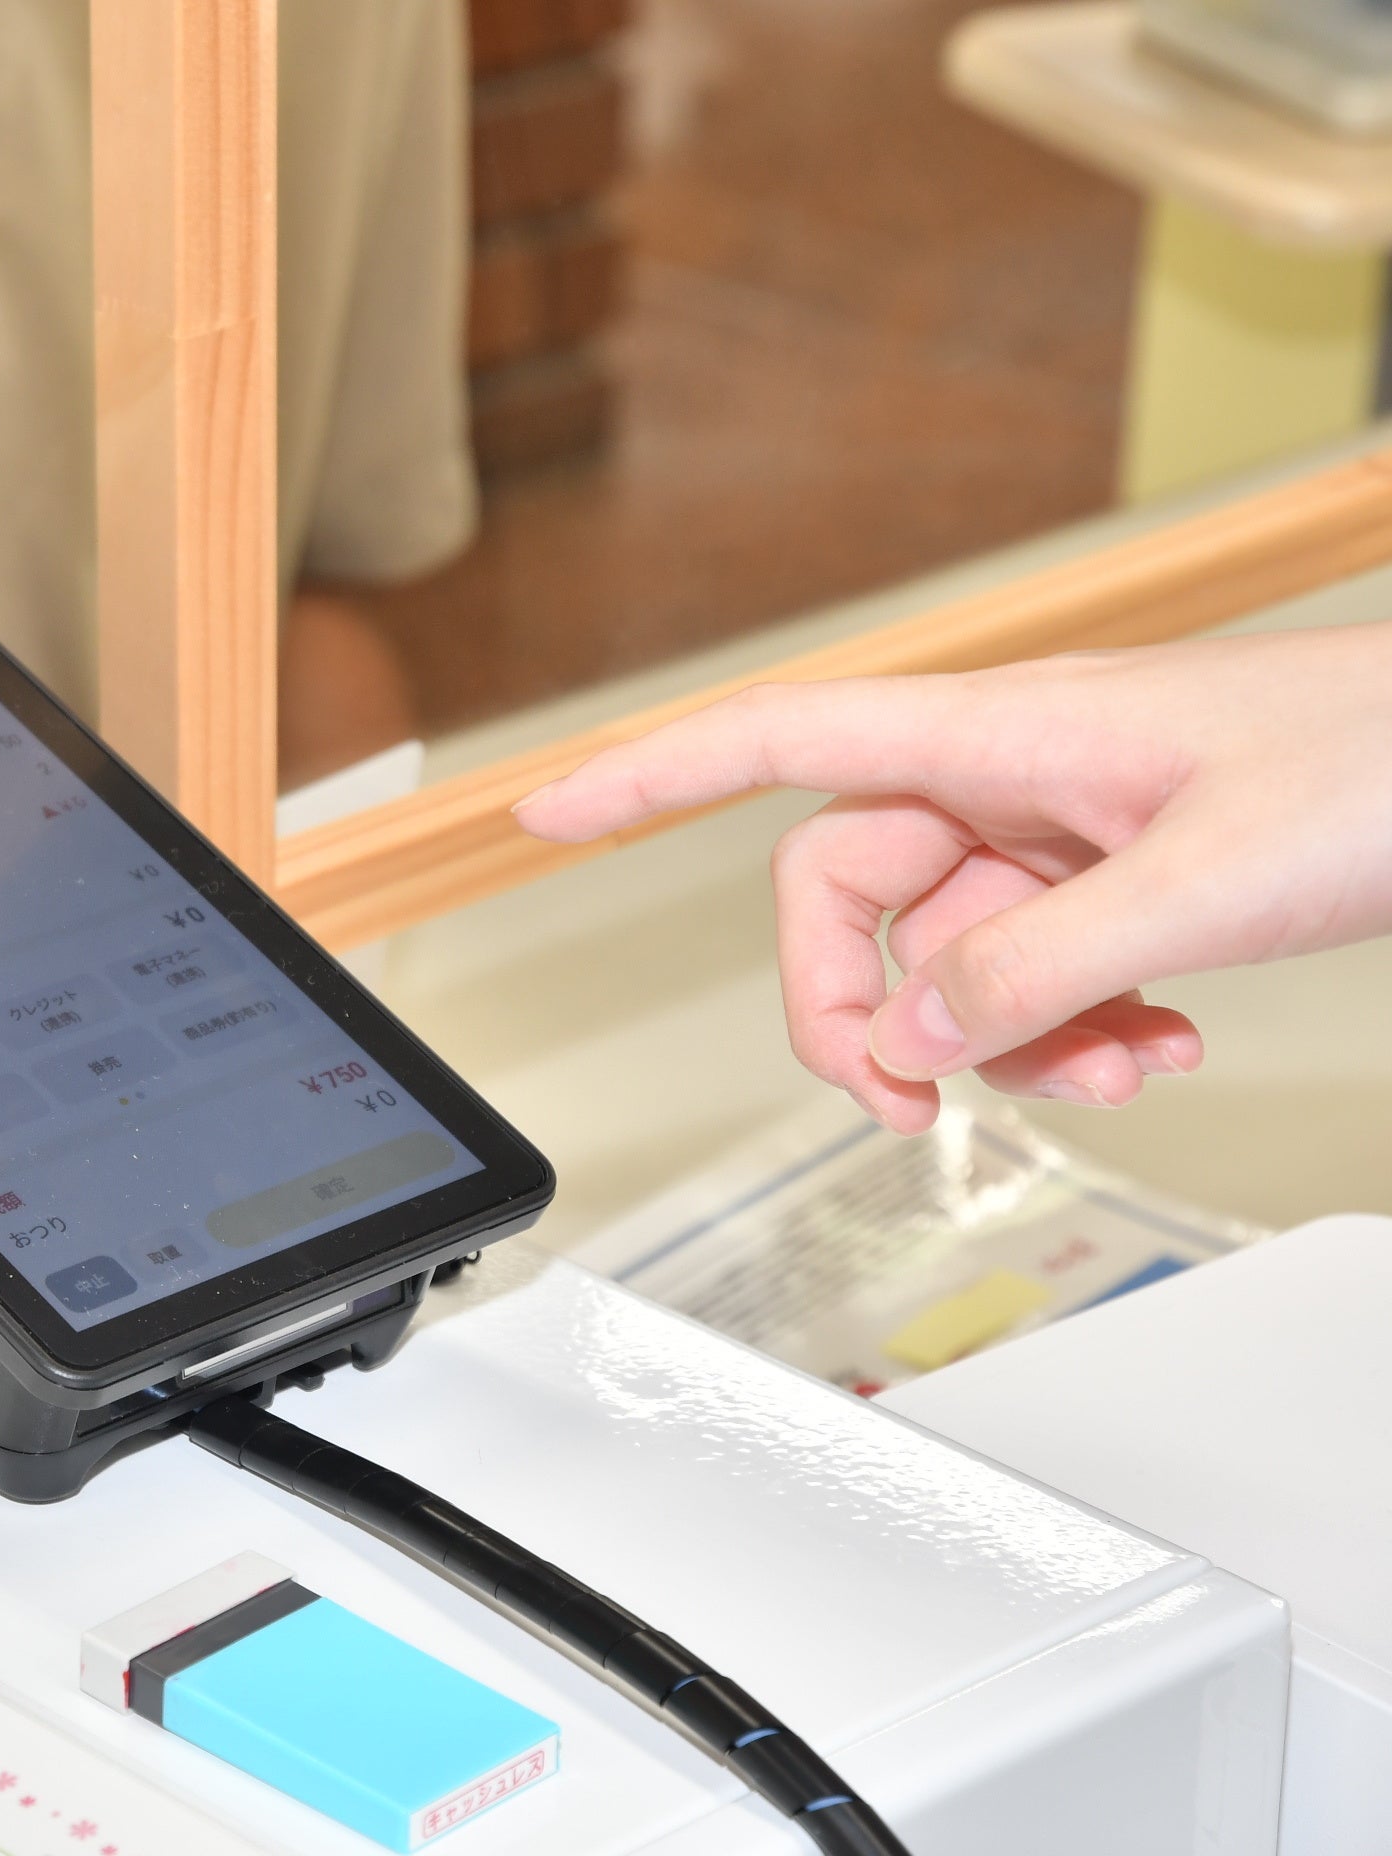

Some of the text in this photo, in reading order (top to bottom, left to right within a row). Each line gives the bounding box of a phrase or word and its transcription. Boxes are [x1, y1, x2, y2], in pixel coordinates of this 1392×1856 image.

[163, 906, 206, 928] ¥0
[9, 988, 79, 1021] クレジット
[298, 1060, 368, 1094] ¥750
[354, 1089, 398, 1113] ¥0
[9, 1215, 67, 1249] おつり
[426, 1754, 544, 1832] キャッシュレス
